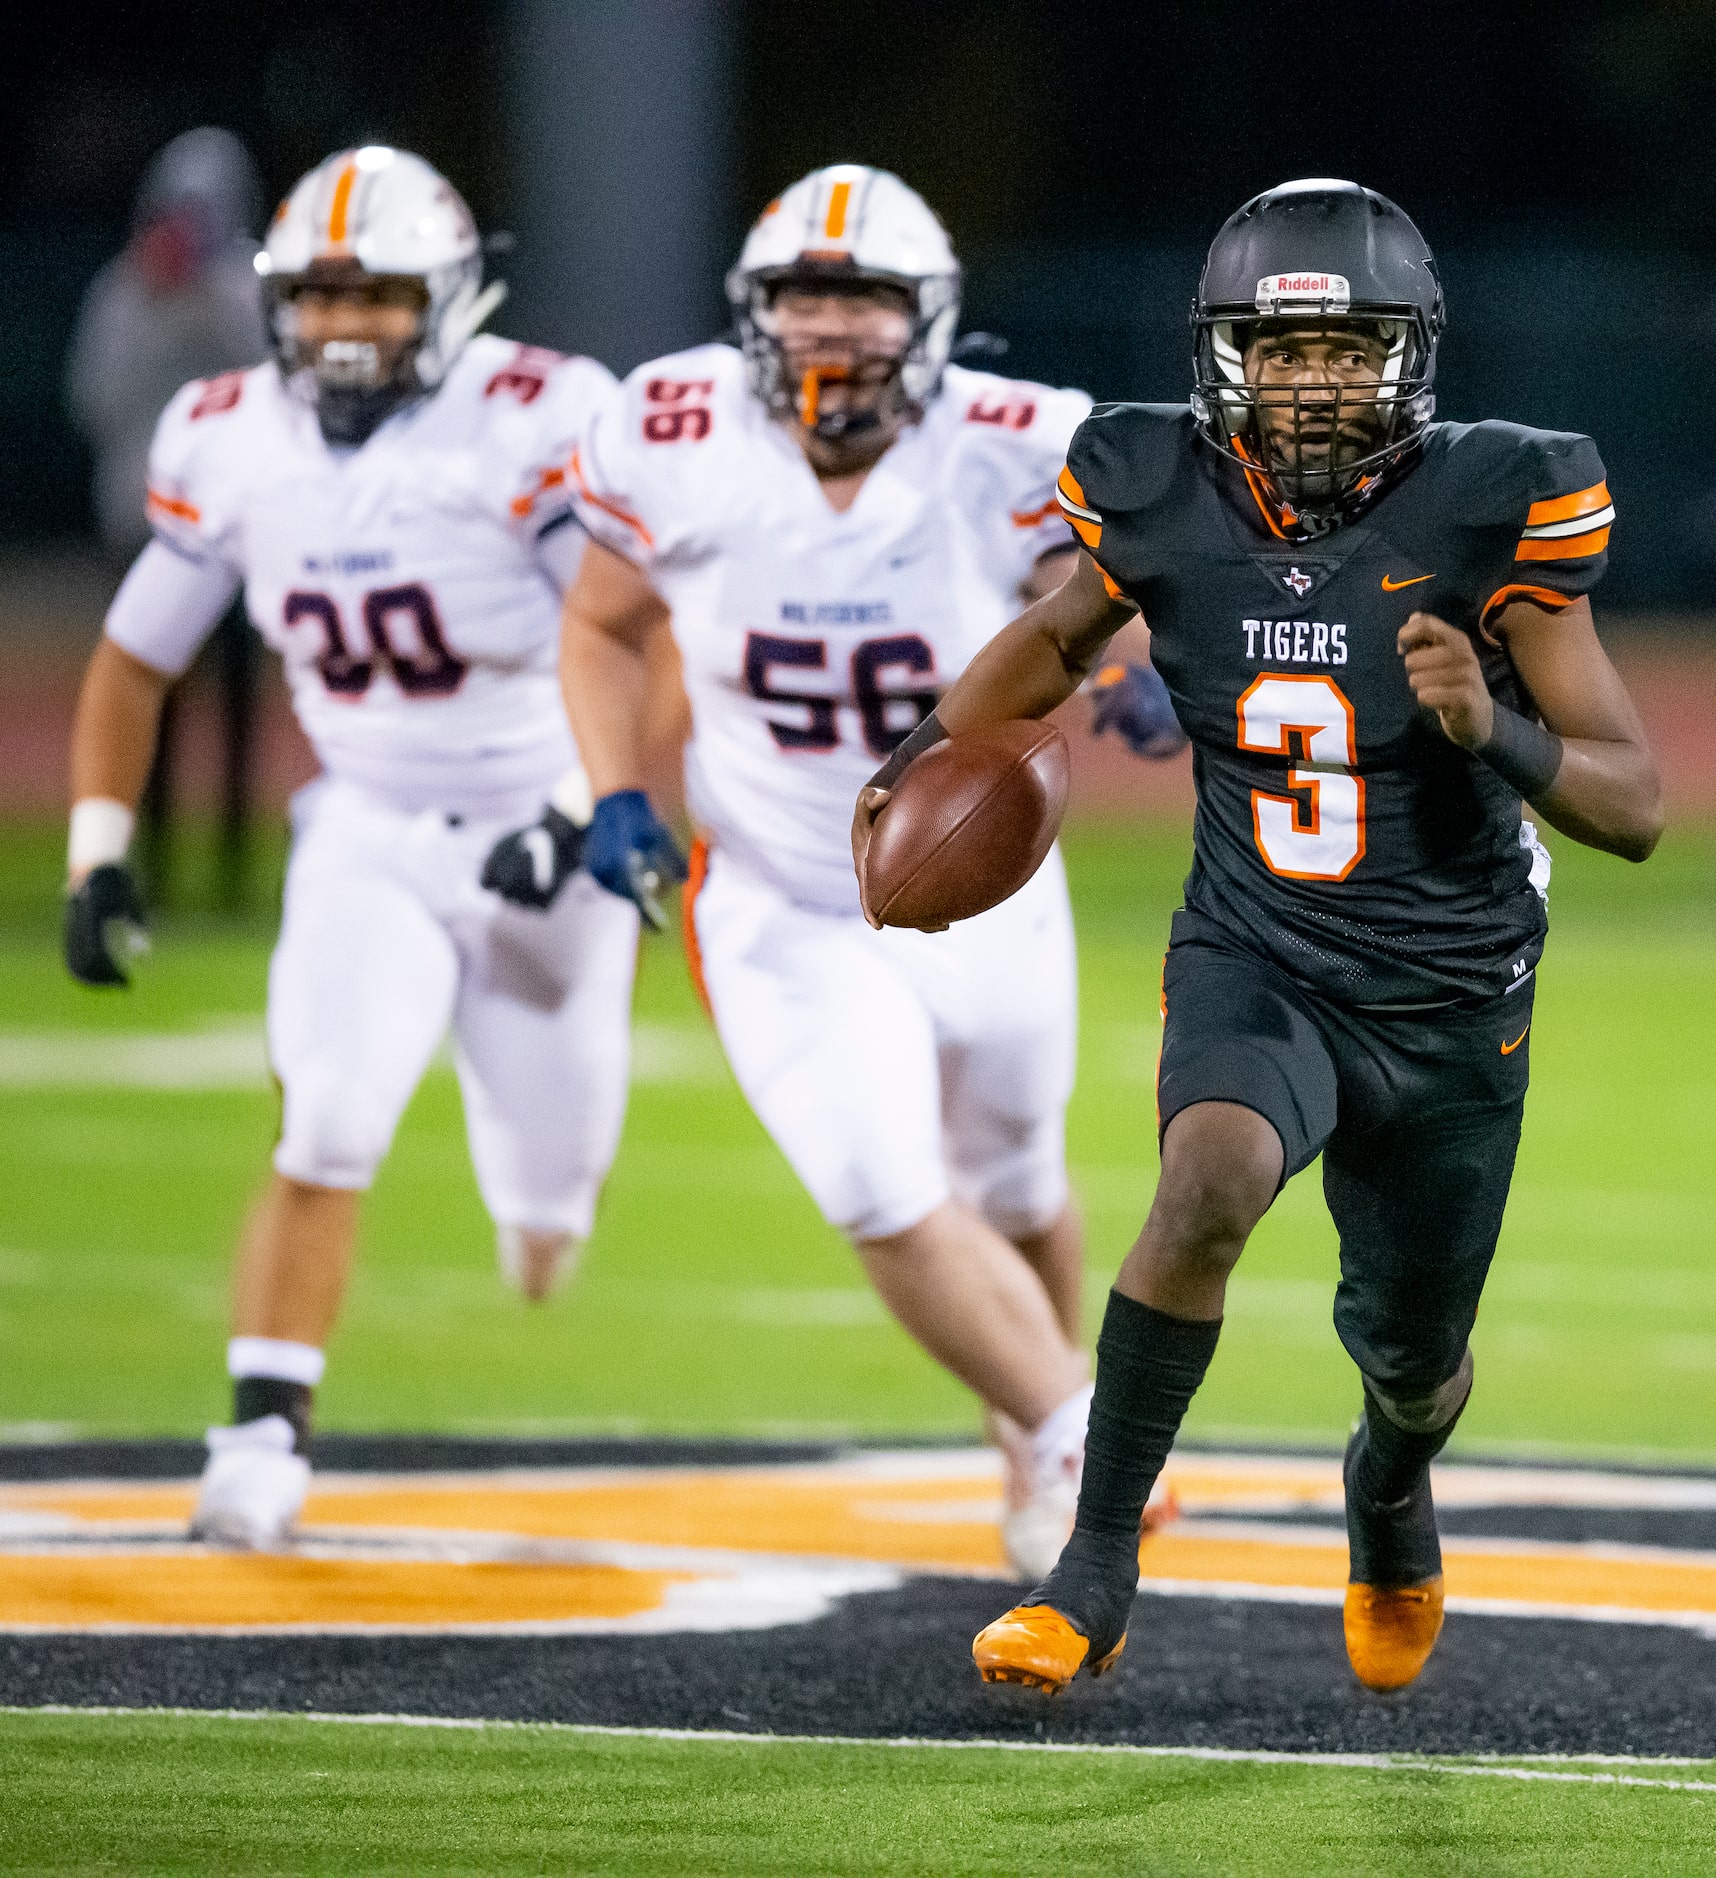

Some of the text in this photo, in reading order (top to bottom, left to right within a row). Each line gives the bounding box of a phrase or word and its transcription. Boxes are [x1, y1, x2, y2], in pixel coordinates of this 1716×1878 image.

[1278, 277, 1329, 291] Riddell
[644, 377, 714, 443] 56
[1242, 619, 1348, 665] TIGERS
[743, 630, 938, 760] 56
[1236, 671, 1366, 882] 3
[1512, 958, 1527, 978] M
